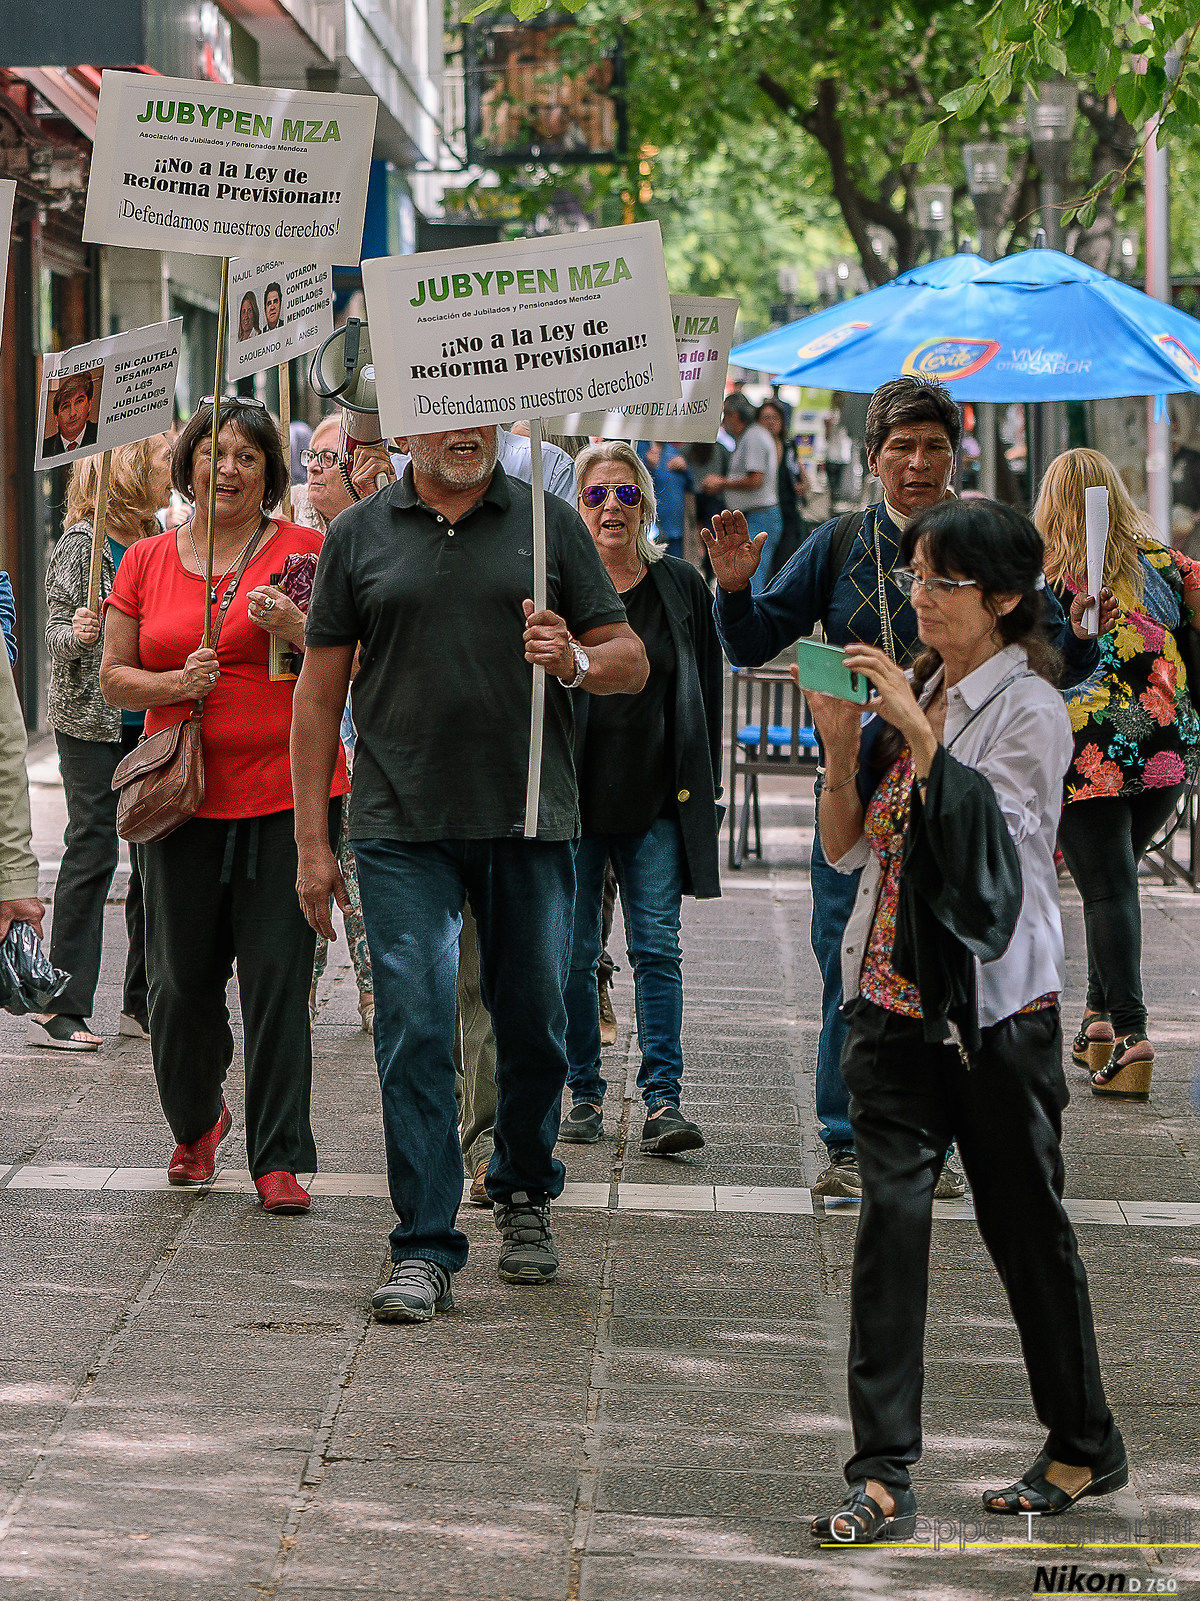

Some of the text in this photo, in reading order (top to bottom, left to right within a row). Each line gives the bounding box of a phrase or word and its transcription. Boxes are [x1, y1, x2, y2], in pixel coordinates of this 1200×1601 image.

[136, 100, 341, 143] JUBYPEN MZA
[139, 131, 178, 142] Asociación
[180, 134, 189, 143] de
[189, 135, 224, 146] Jubilados
[231, 140, 276, 151] Pensionados
[278, 144, 308, 153] Mendoza
[154, 157, 308, 184] ¡¡No a la Ley de
[123, 172, 341, 205] Reforma Previsional!!
[118, 198, 340, 239] ¡Defendamos nuestros derechos!
[232, 270, 252, 284] NAJUL
[285, 263, 317, 281] VOTARON
[409, 256, 633, 308] JUBYPEN MZA
[286, 278, 313, 295] CONTRA
[417, 312, 460, 324] Asociación
[462, 310, 472, 319] de
[473, 304, 511, 317] Jubilados
[519, 298, 567, 312] Pensionados
[569, 292, 602, 304] Mendoza
[684, 316, 719, 335] MZA
[239, 325, 319, 364] SAQUEANDO AL ANSES
[440, 319, 609, 358] ¡¡No a la Ley de
[114, 347, 178, 372] SIN CAUTELA
[411, 334, 647, 379] Reforma Previsional!!
[689, 350, 705, 362] de
[707, 349, 718, 361] la
[1028, 359, 1092, 375] SABOR
[45, 357, 104, 379] JUEZ BENTO
[115, 361, 174, 384] DESAMPARA
[125, 386, 132, 394] A
[412, 362, 654, 417] ¡Defendamos nuestros derechos!
[651, 402, 665, 416] DE
